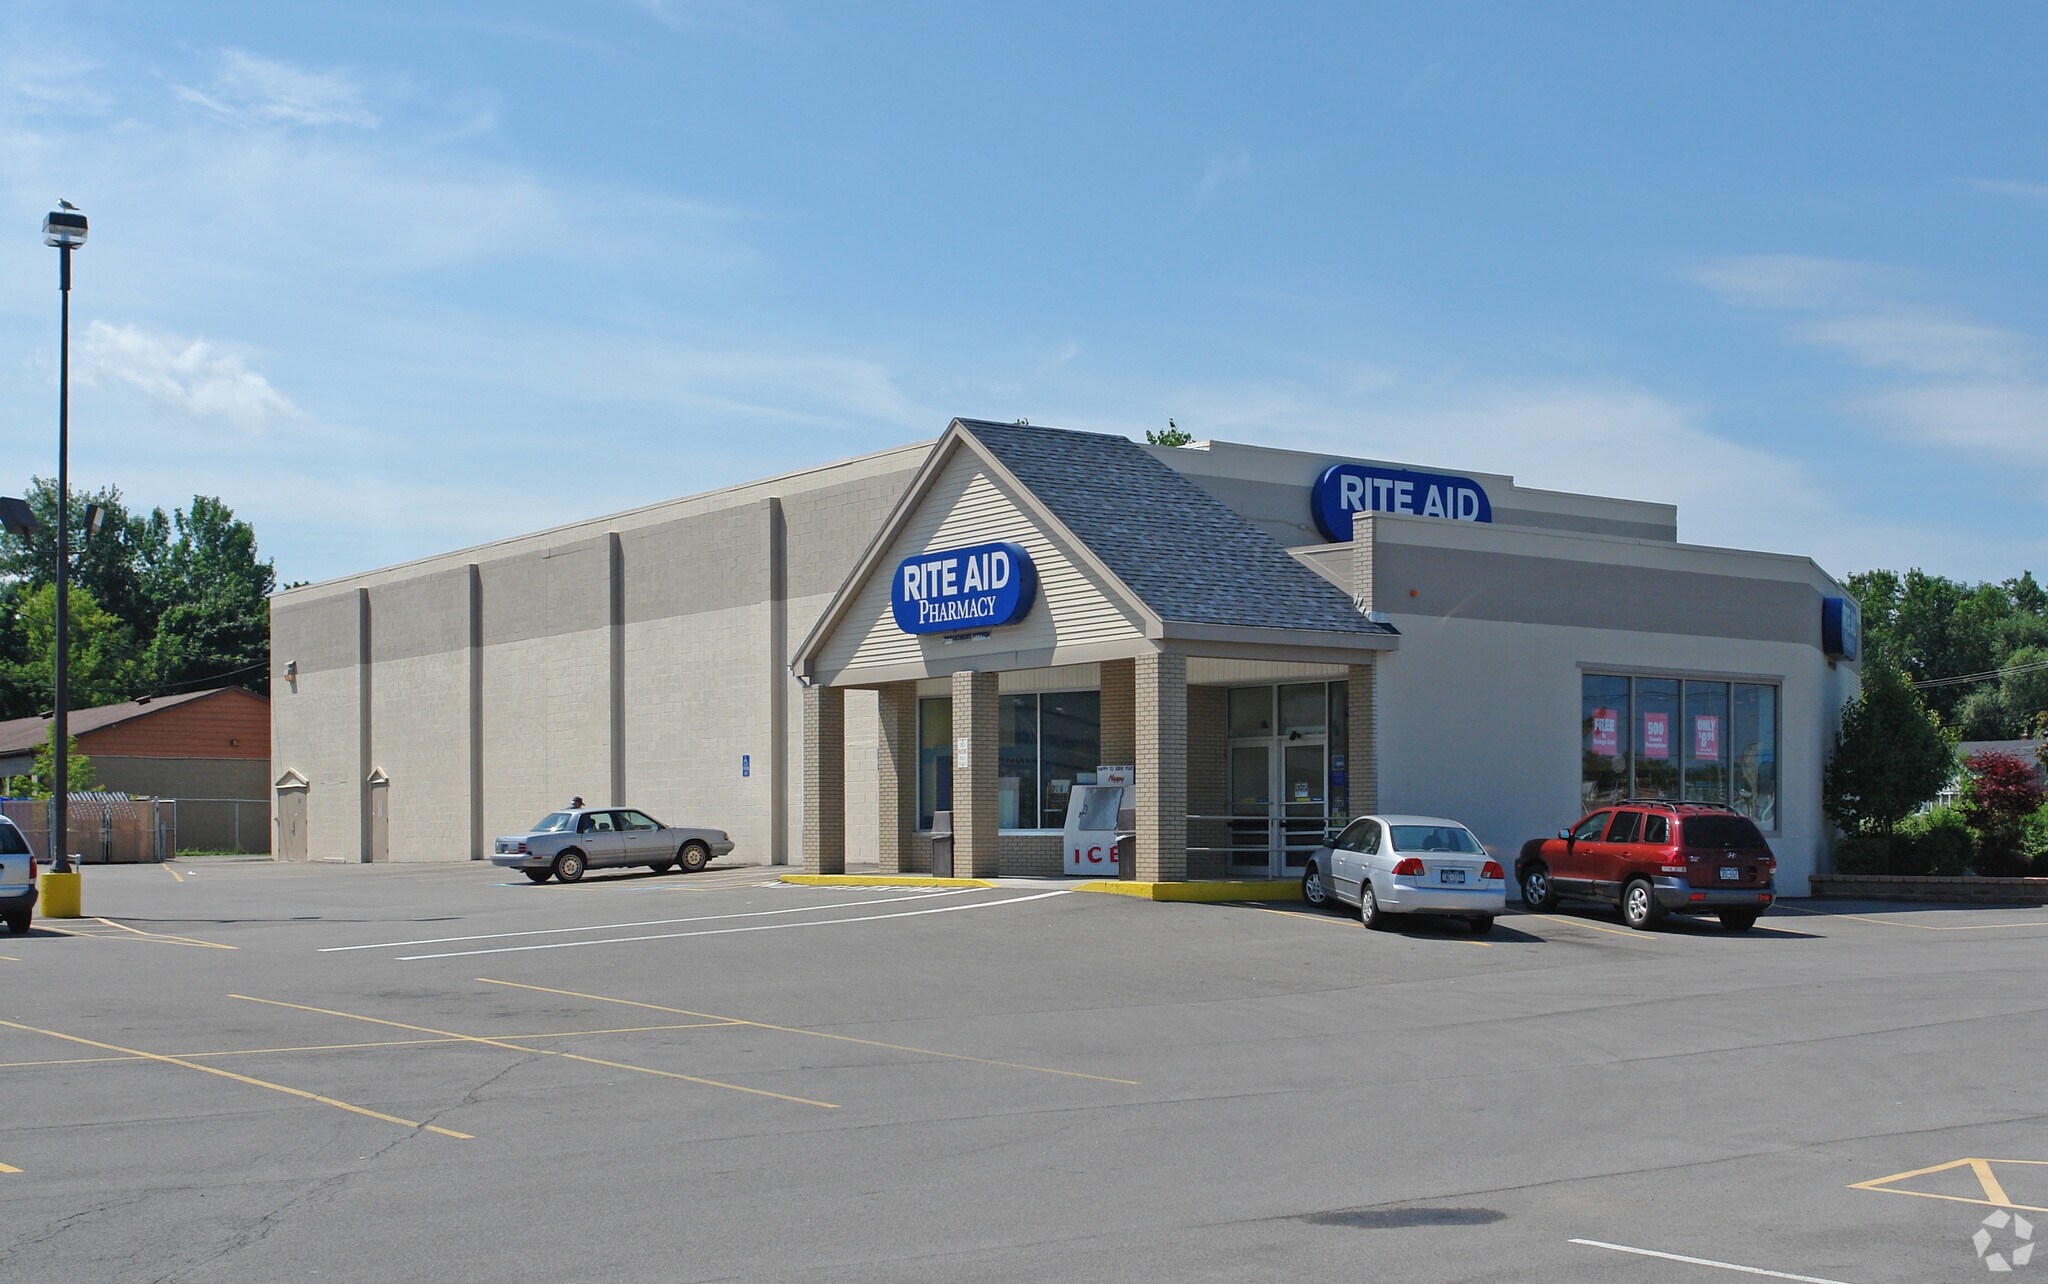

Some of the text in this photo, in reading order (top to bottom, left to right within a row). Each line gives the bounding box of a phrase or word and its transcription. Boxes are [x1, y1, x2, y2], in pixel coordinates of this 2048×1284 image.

[1340, 474, 1479, 523] RITE AID
[903, 551, 1010, 602] RITE AID
[918, 595, 997, 625] PHARMACY
[1594, 717, 1615, 732] FREE
[1648, 721, 1664, 735] 500
[1697, 719, 1716, 731] ONLY
[1074, 845, 1119, 864] ICE
